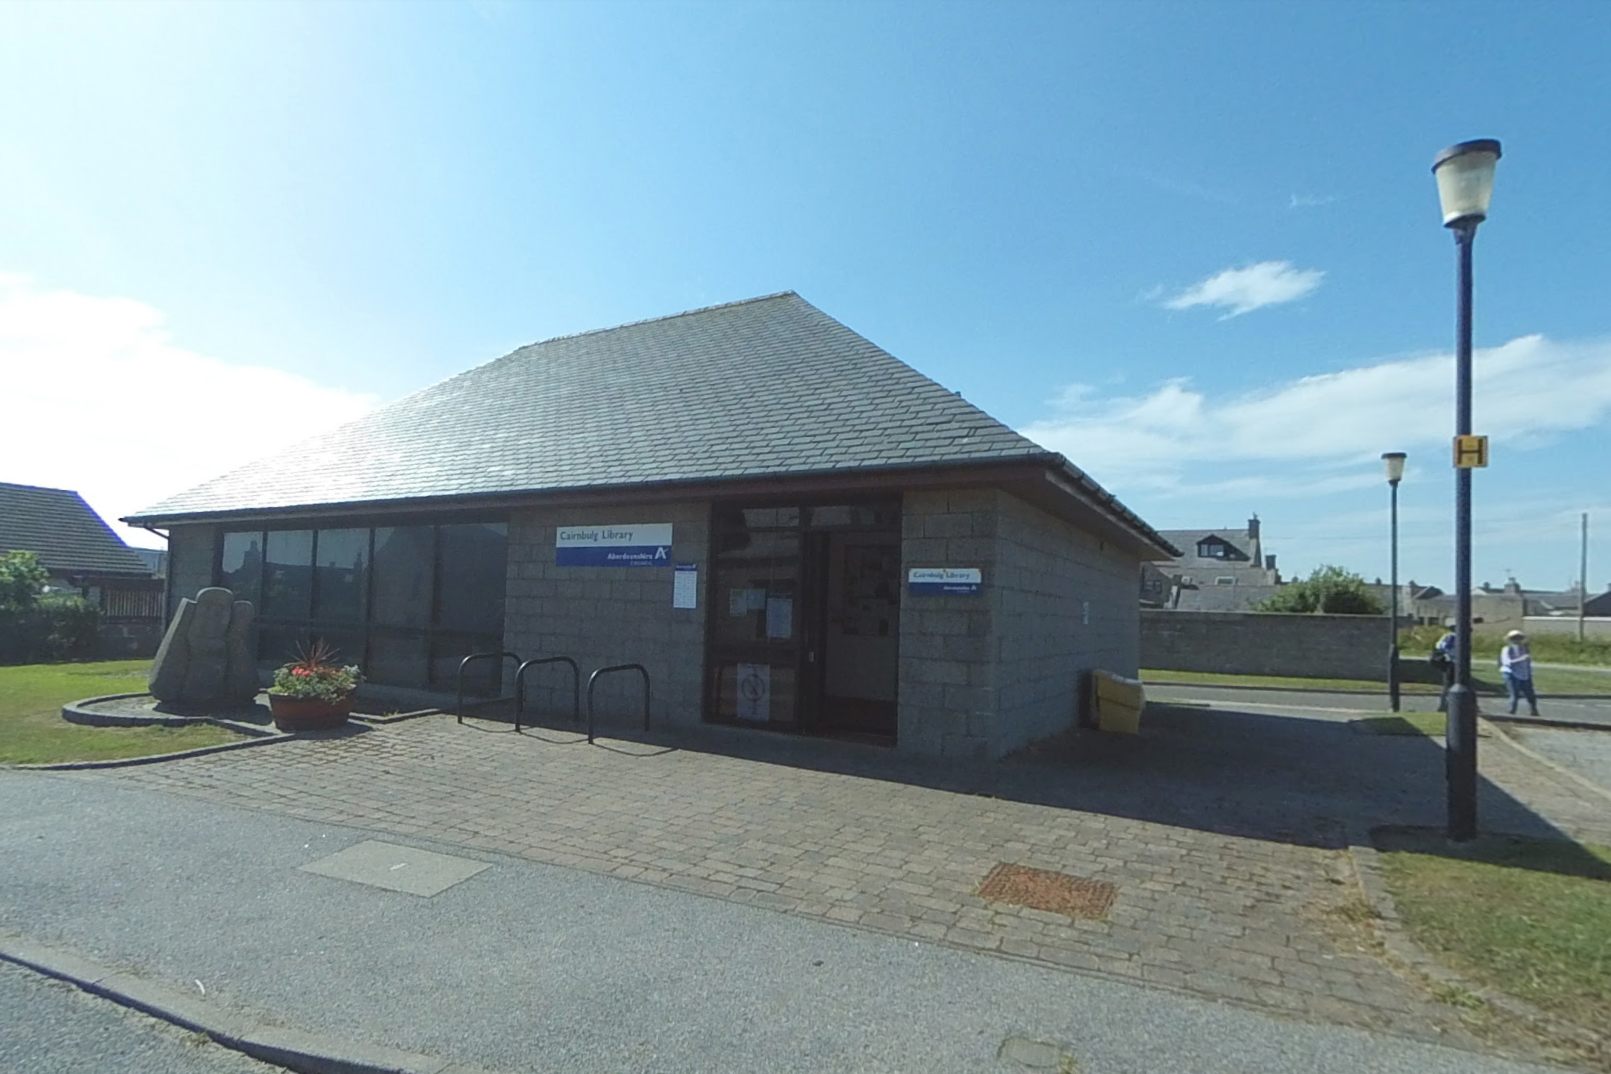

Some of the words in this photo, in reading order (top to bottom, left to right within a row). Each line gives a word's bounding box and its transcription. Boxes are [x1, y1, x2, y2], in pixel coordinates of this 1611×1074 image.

[1457, 439, 1484, 465] H
[560, 530, 599, 542] Cairnbulg
[602, 529, 634, 542] Library
[946, 571, 970, 580] Library
